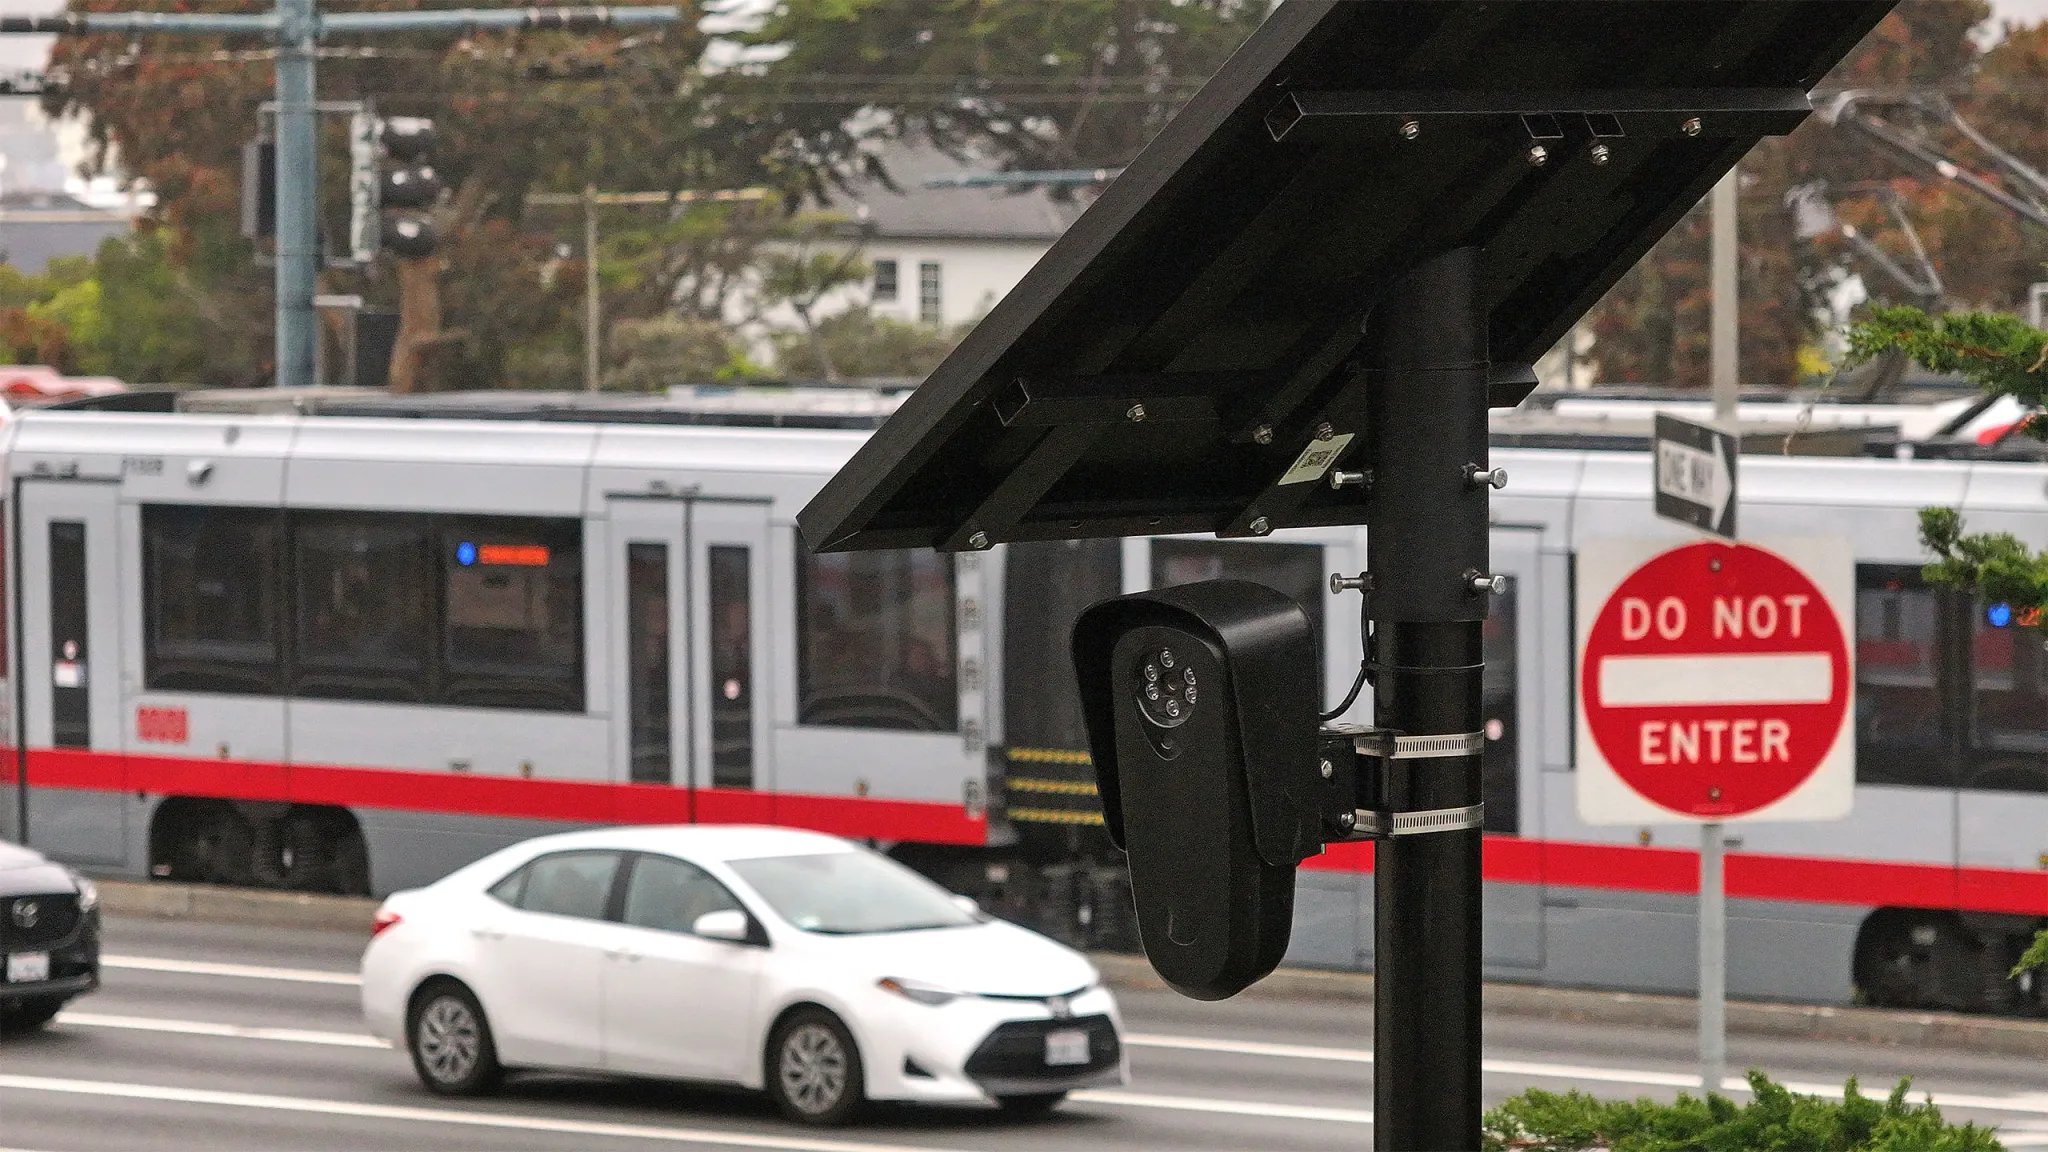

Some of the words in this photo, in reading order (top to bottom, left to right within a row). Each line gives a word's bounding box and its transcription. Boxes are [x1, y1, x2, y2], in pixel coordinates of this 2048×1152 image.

[1620, 596, 1687, 641] DO
[1712, 593, 1809, 640] NOT
[1638, 717, 1791, 765] ENTER
